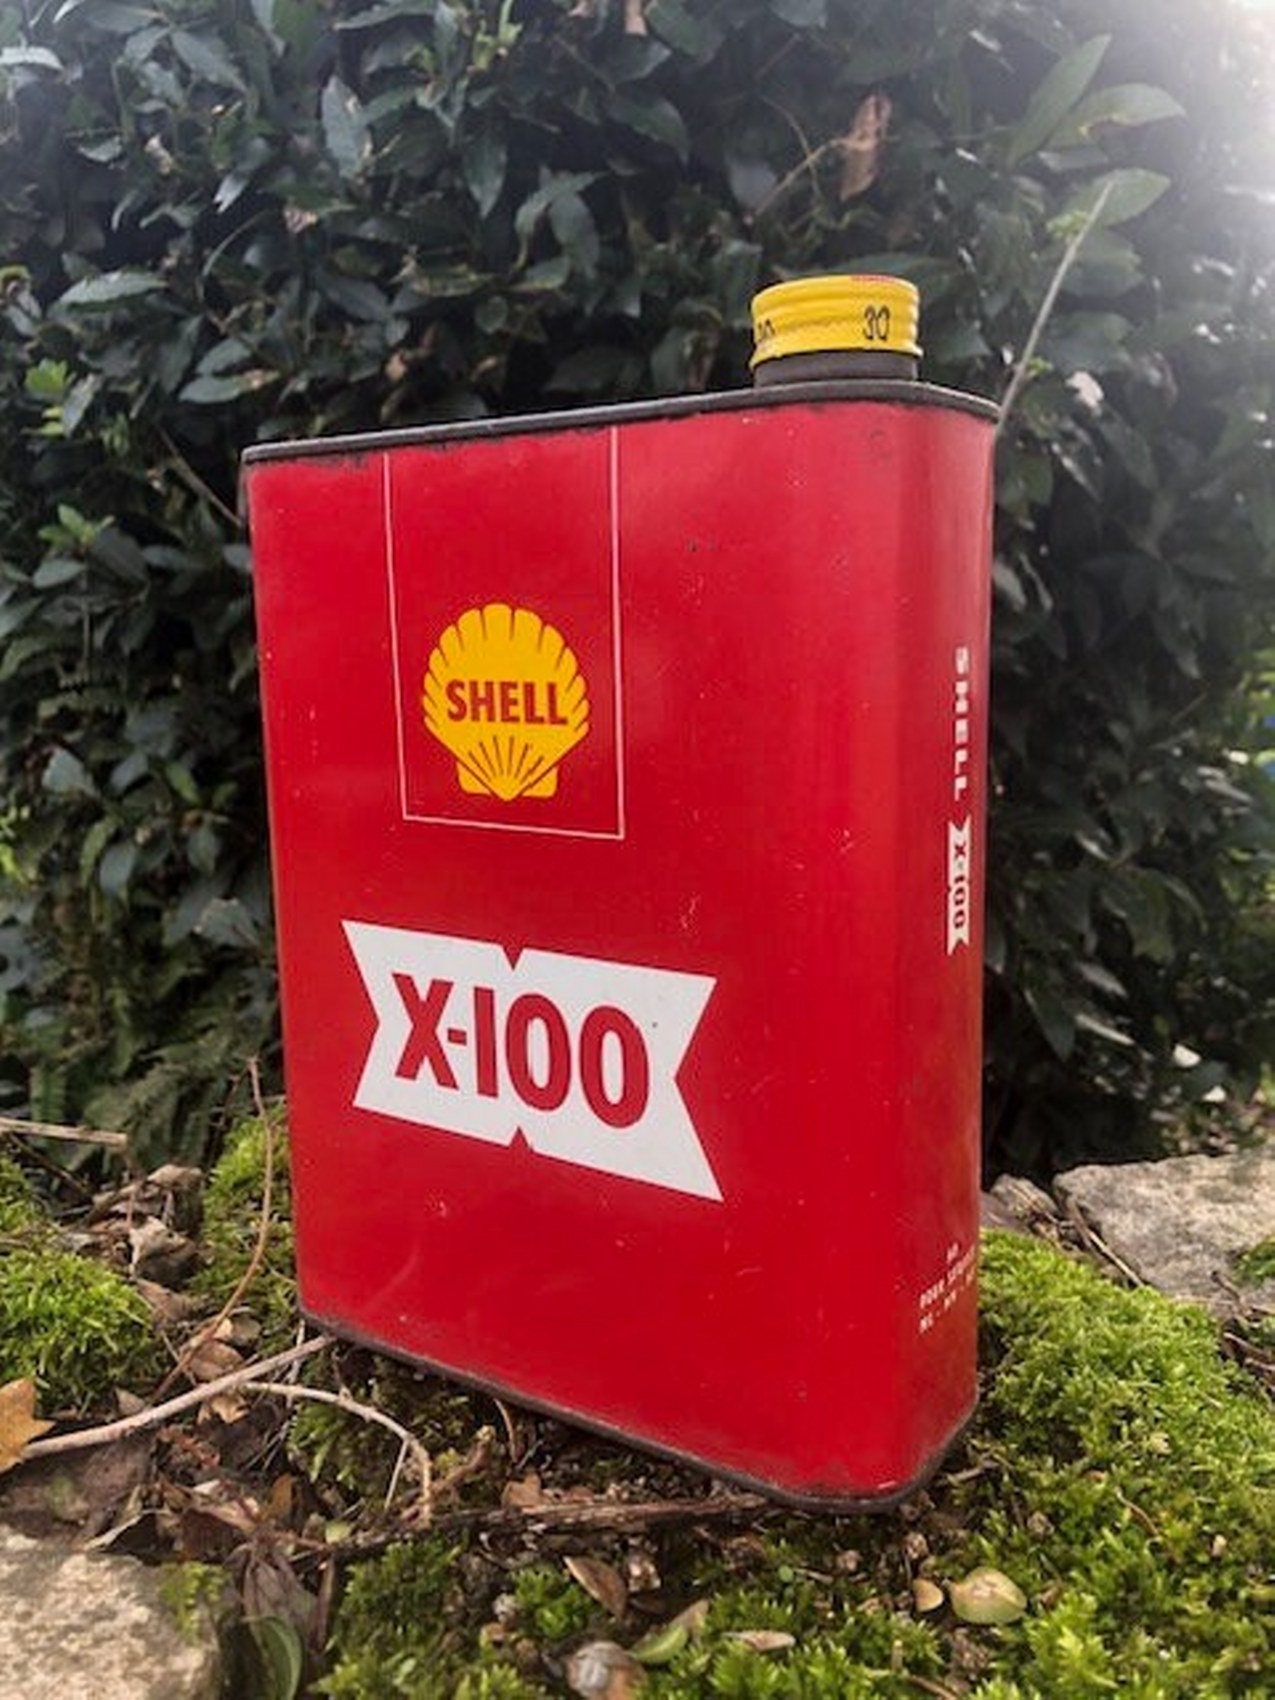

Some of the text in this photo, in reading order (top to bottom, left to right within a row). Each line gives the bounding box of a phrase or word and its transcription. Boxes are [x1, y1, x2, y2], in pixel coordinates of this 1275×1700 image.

[863, 304, 890, 342] 30
[445, 679, 568, 726] SHELL
[954, 646, 970, 801] SHELL
[391, 972, 650, 1129] X-100
